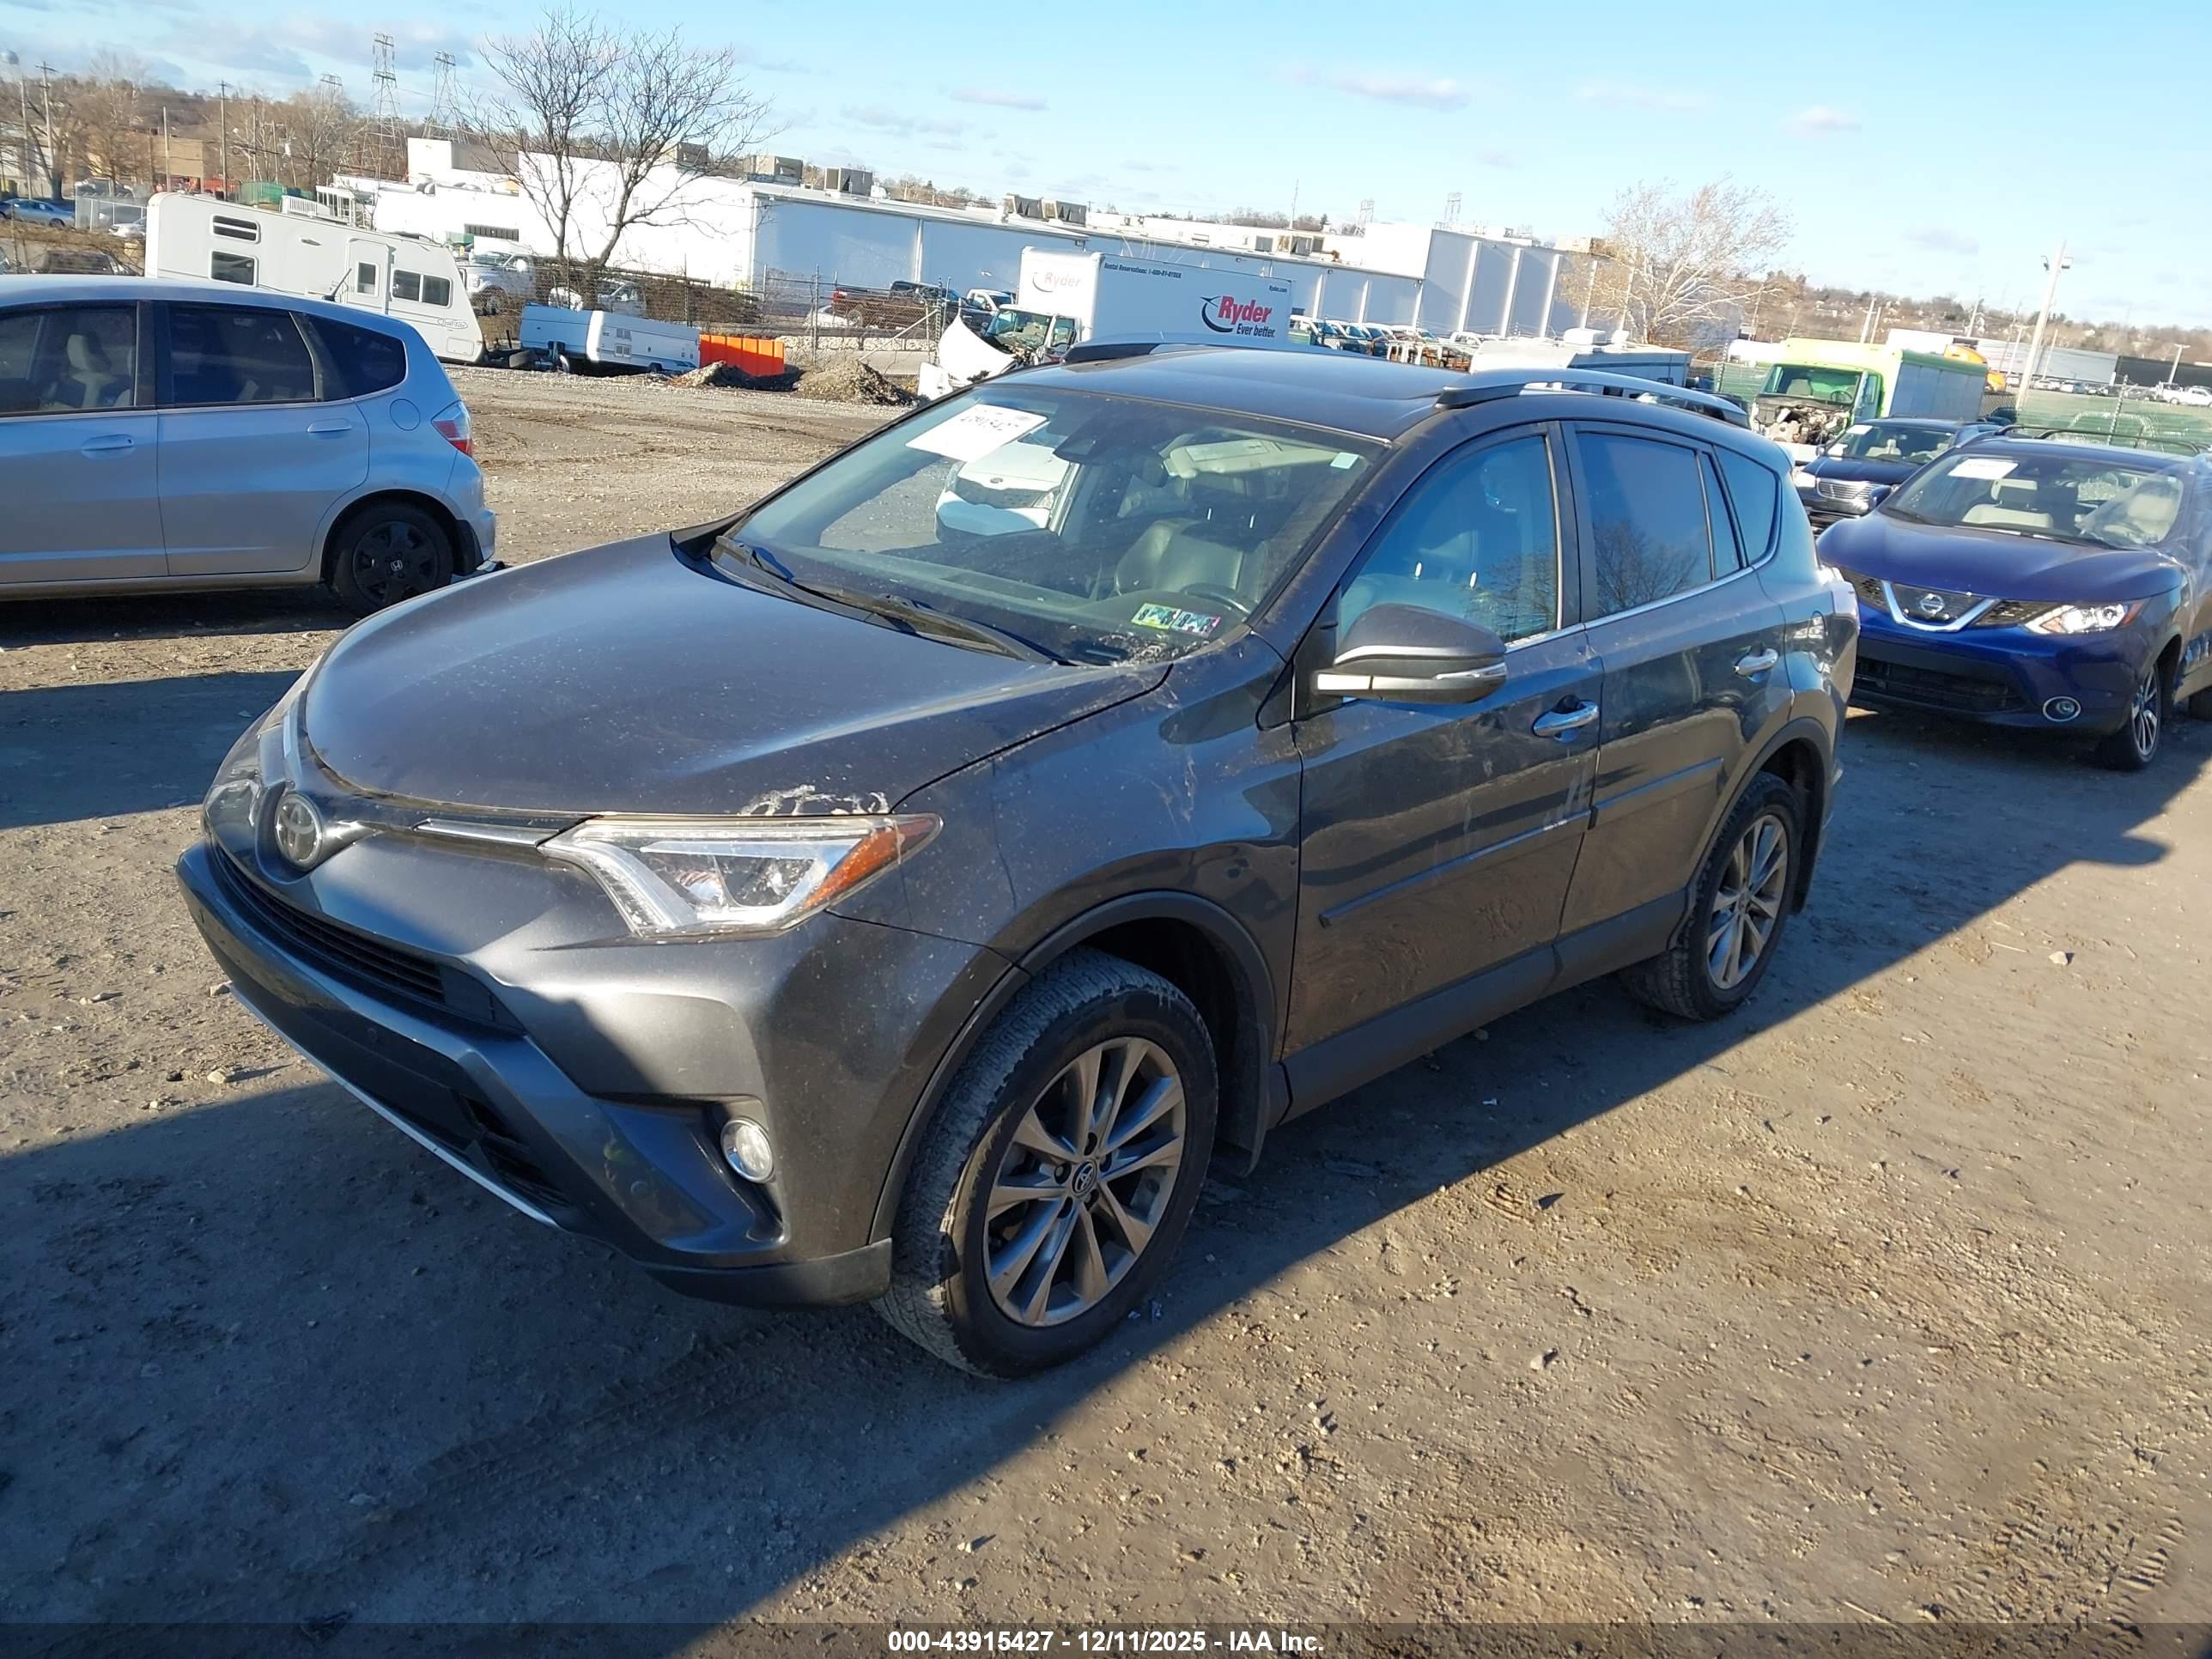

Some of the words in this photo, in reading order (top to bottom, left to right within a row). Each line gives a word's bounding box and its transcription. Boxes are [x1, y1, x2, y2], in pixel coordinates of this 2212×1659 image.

[1044, 271, 1081, 289] Ryder
[1218, 295, 1273, 325] Ryder
[1237, 323, 1253, 336] Ever
[1253, 325, 1275, 338] better.
